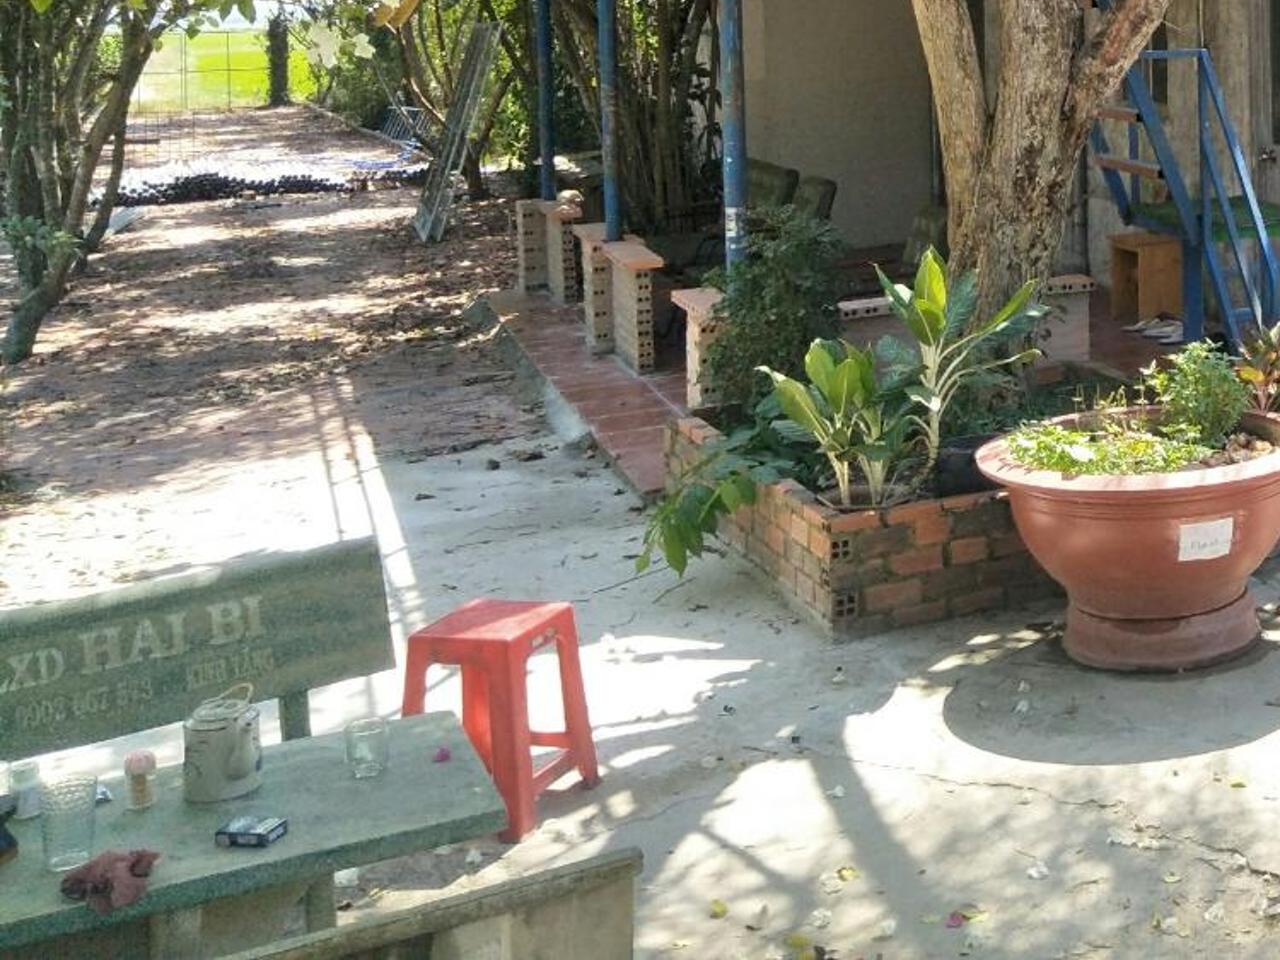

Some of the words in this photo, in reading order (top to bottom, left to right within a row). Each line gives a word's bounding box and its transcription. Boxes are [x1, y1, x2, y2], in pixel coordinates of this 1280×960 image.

[0, 647, 65, 692] XD
[80, 611, 191, 675] HAI
[205, 594, 268, 646] BI
